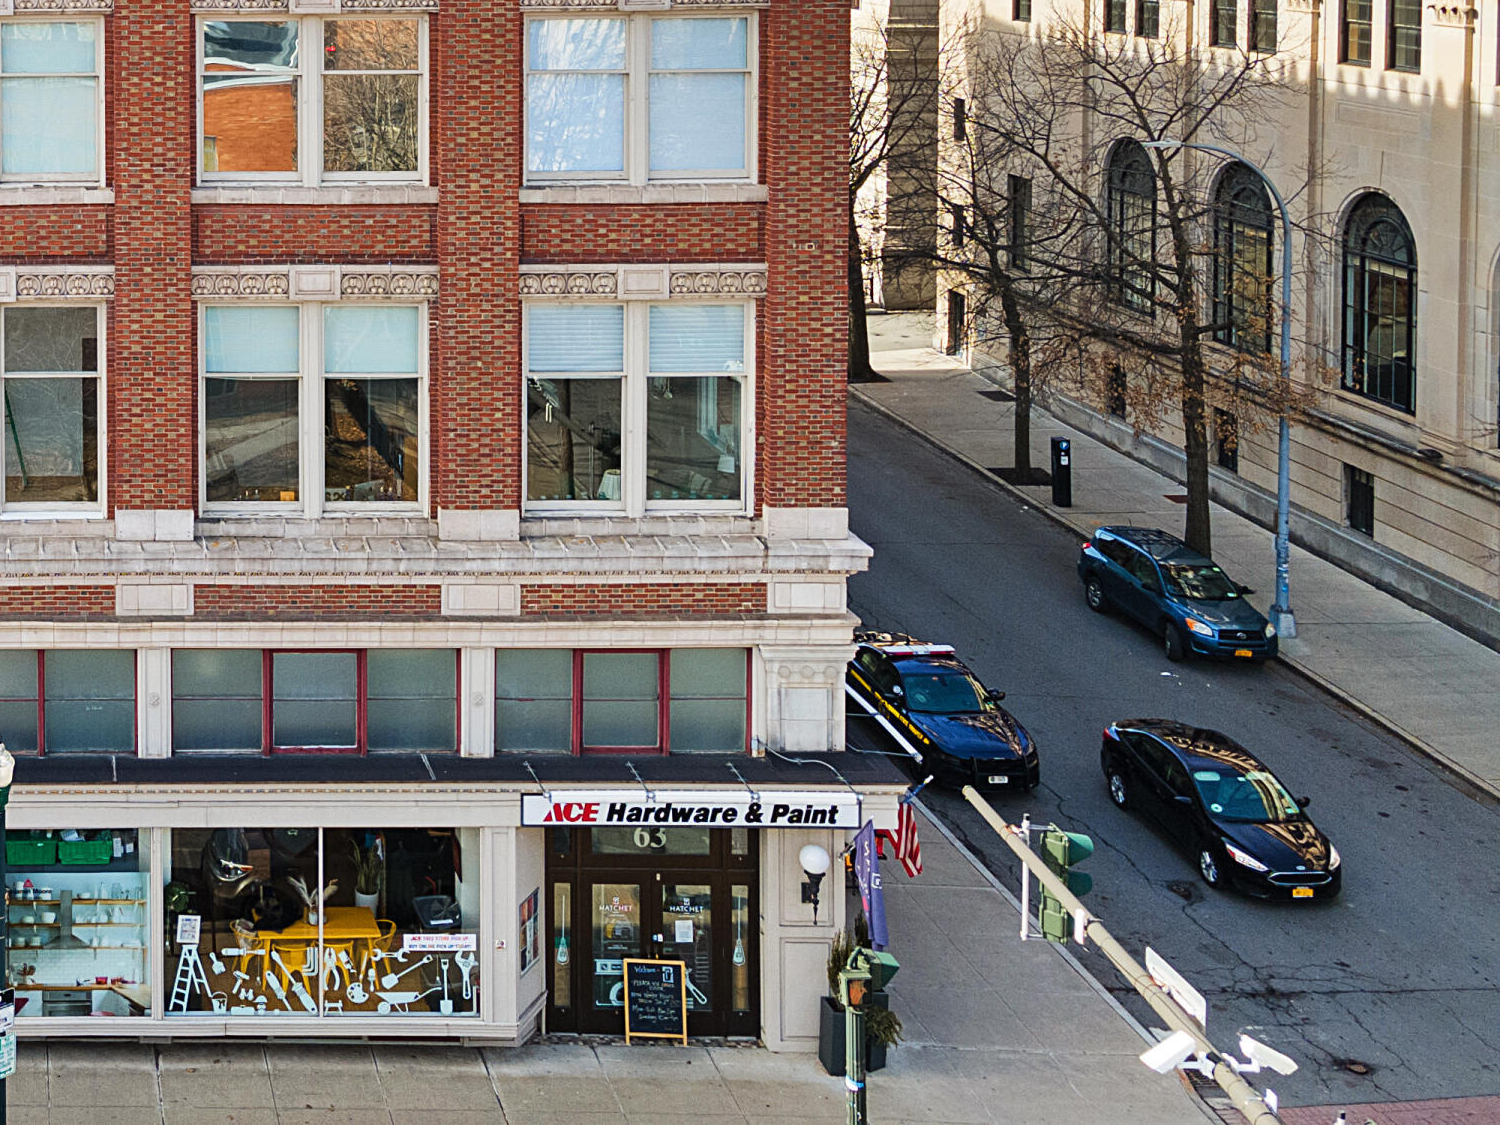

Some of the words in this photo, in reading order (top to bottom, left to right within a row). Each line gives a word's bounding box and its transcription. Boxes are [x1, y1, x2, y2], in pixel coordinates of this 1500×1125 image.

[543, 802, 600, 822] ACE
[606, 802, 738, 823] Hardware
[745, 802, 764, 824] &
[770, 804, 839, 824] Paint
[634, 827, 667, 848] 63
[599, 904, 633, 912] HATCHET
[669, 905, 703, 913] HATCHET
